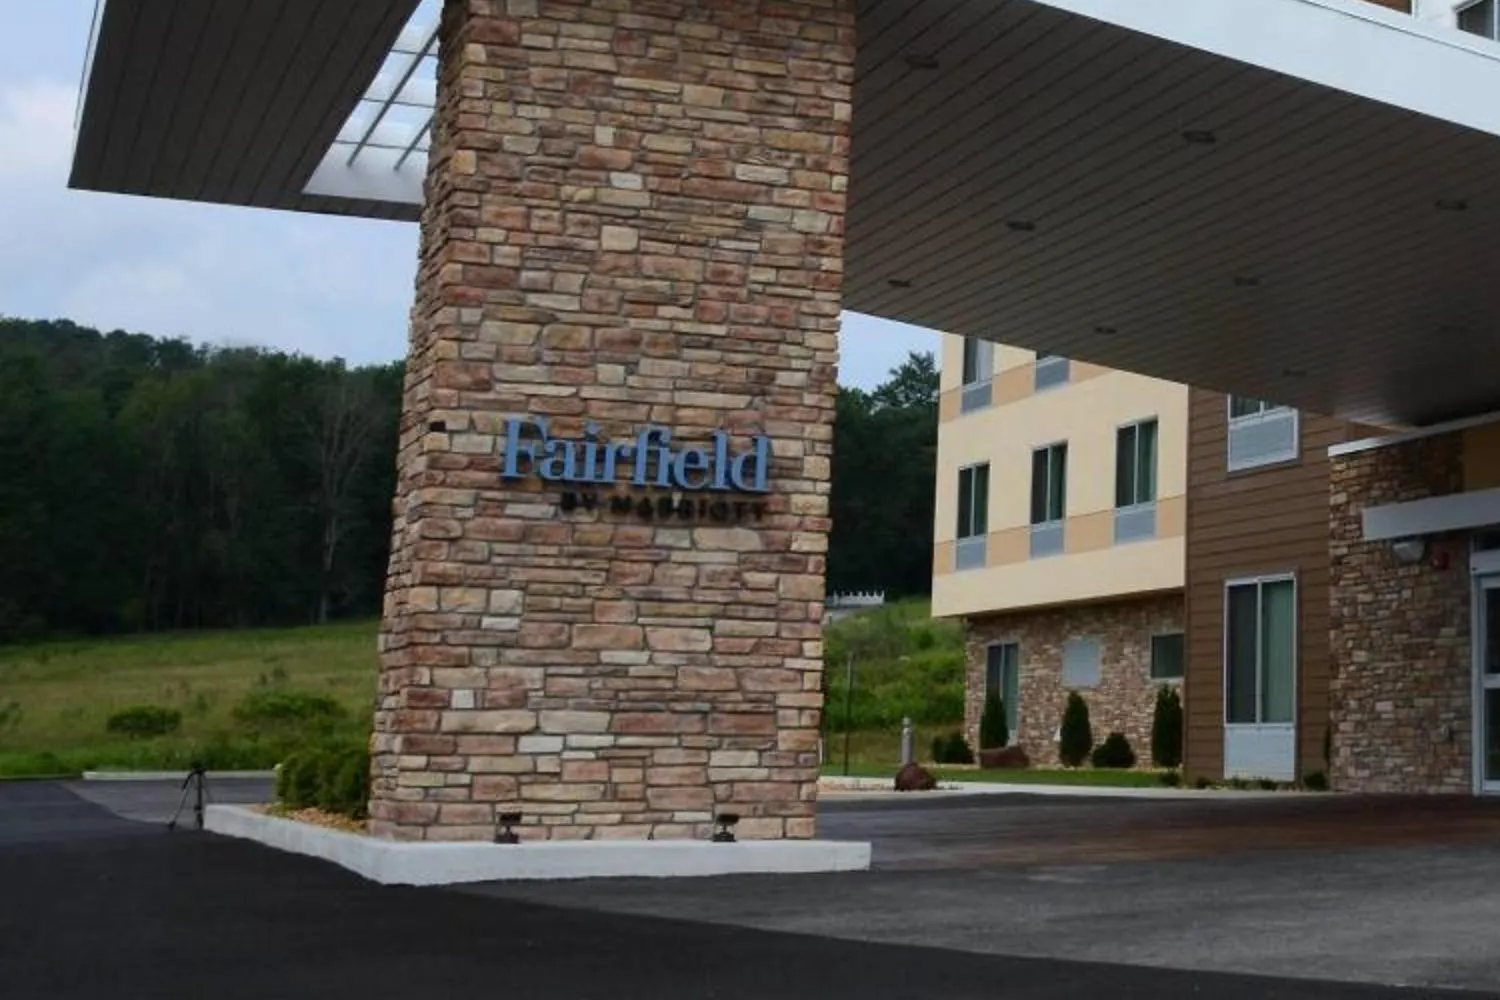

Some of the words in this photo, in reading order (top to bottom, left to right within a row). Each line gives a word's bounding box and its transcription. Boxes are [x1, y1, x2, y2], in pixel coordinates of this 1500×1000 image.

[500, 414, 773, 493] Fairfield
[560, 490, 599, 512] BY
[609, 494, 765, 522] MARRIOTT
